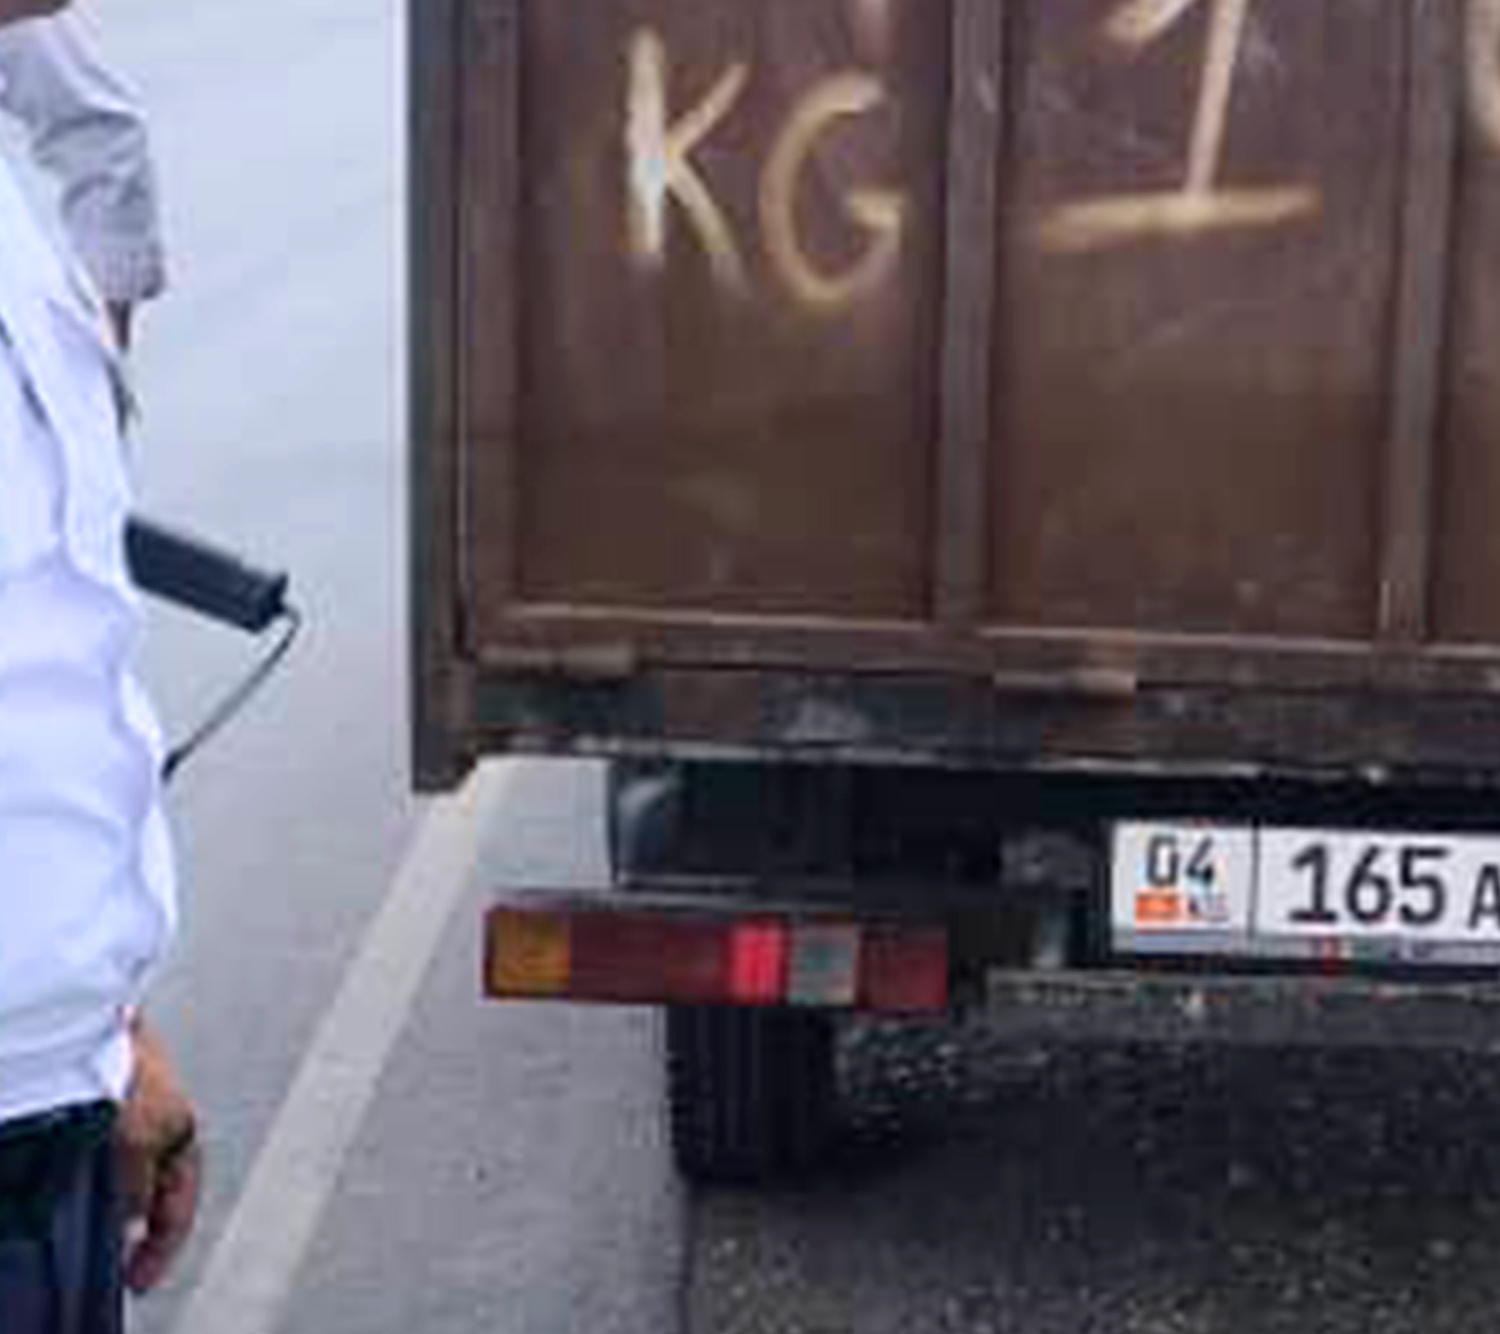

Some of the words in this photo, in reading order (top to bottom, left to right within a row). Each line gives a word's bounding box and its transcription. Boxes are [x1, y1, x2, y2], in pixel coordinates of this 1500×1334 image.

[624, 23, 902, 307] KG
[1145, 834, 1216, 887] 04
[1287, 842, 1450, 927] 165
